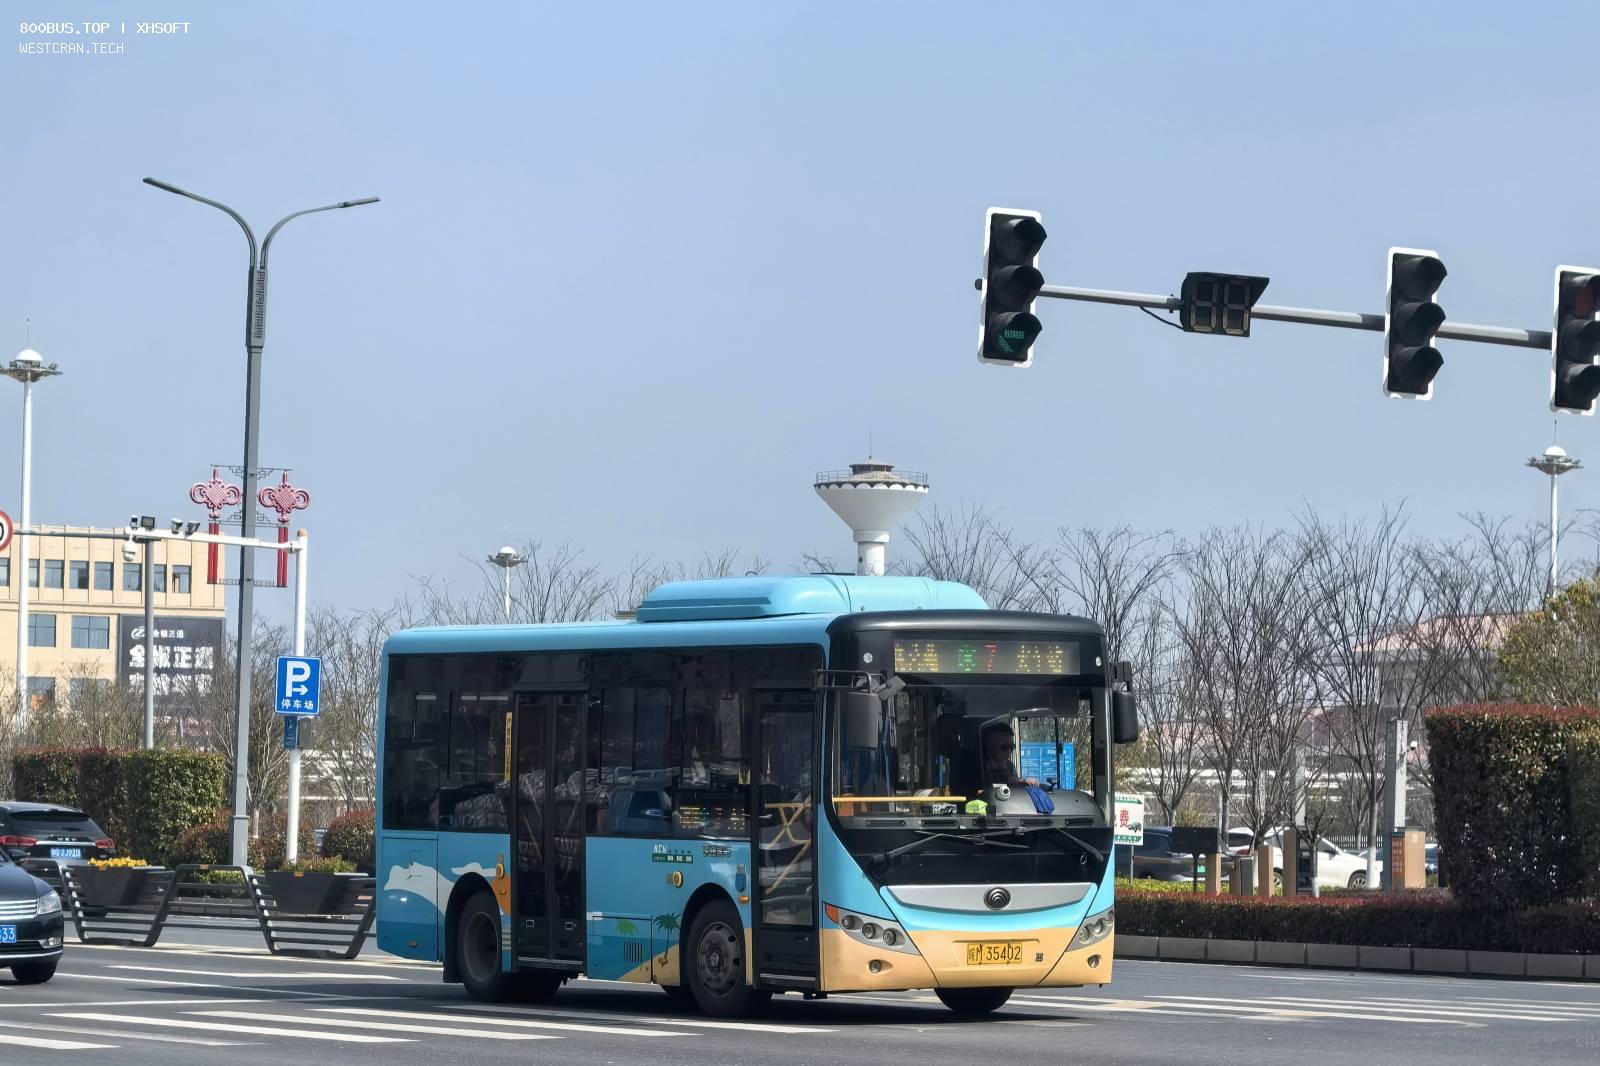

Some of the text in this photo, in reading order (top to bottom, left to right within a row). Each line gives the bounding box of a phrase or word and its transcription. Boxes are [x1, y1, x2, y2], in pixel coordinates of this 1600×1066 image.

[285, 660, 311, 697] P
[281, 698, 314, 710] 停车场
